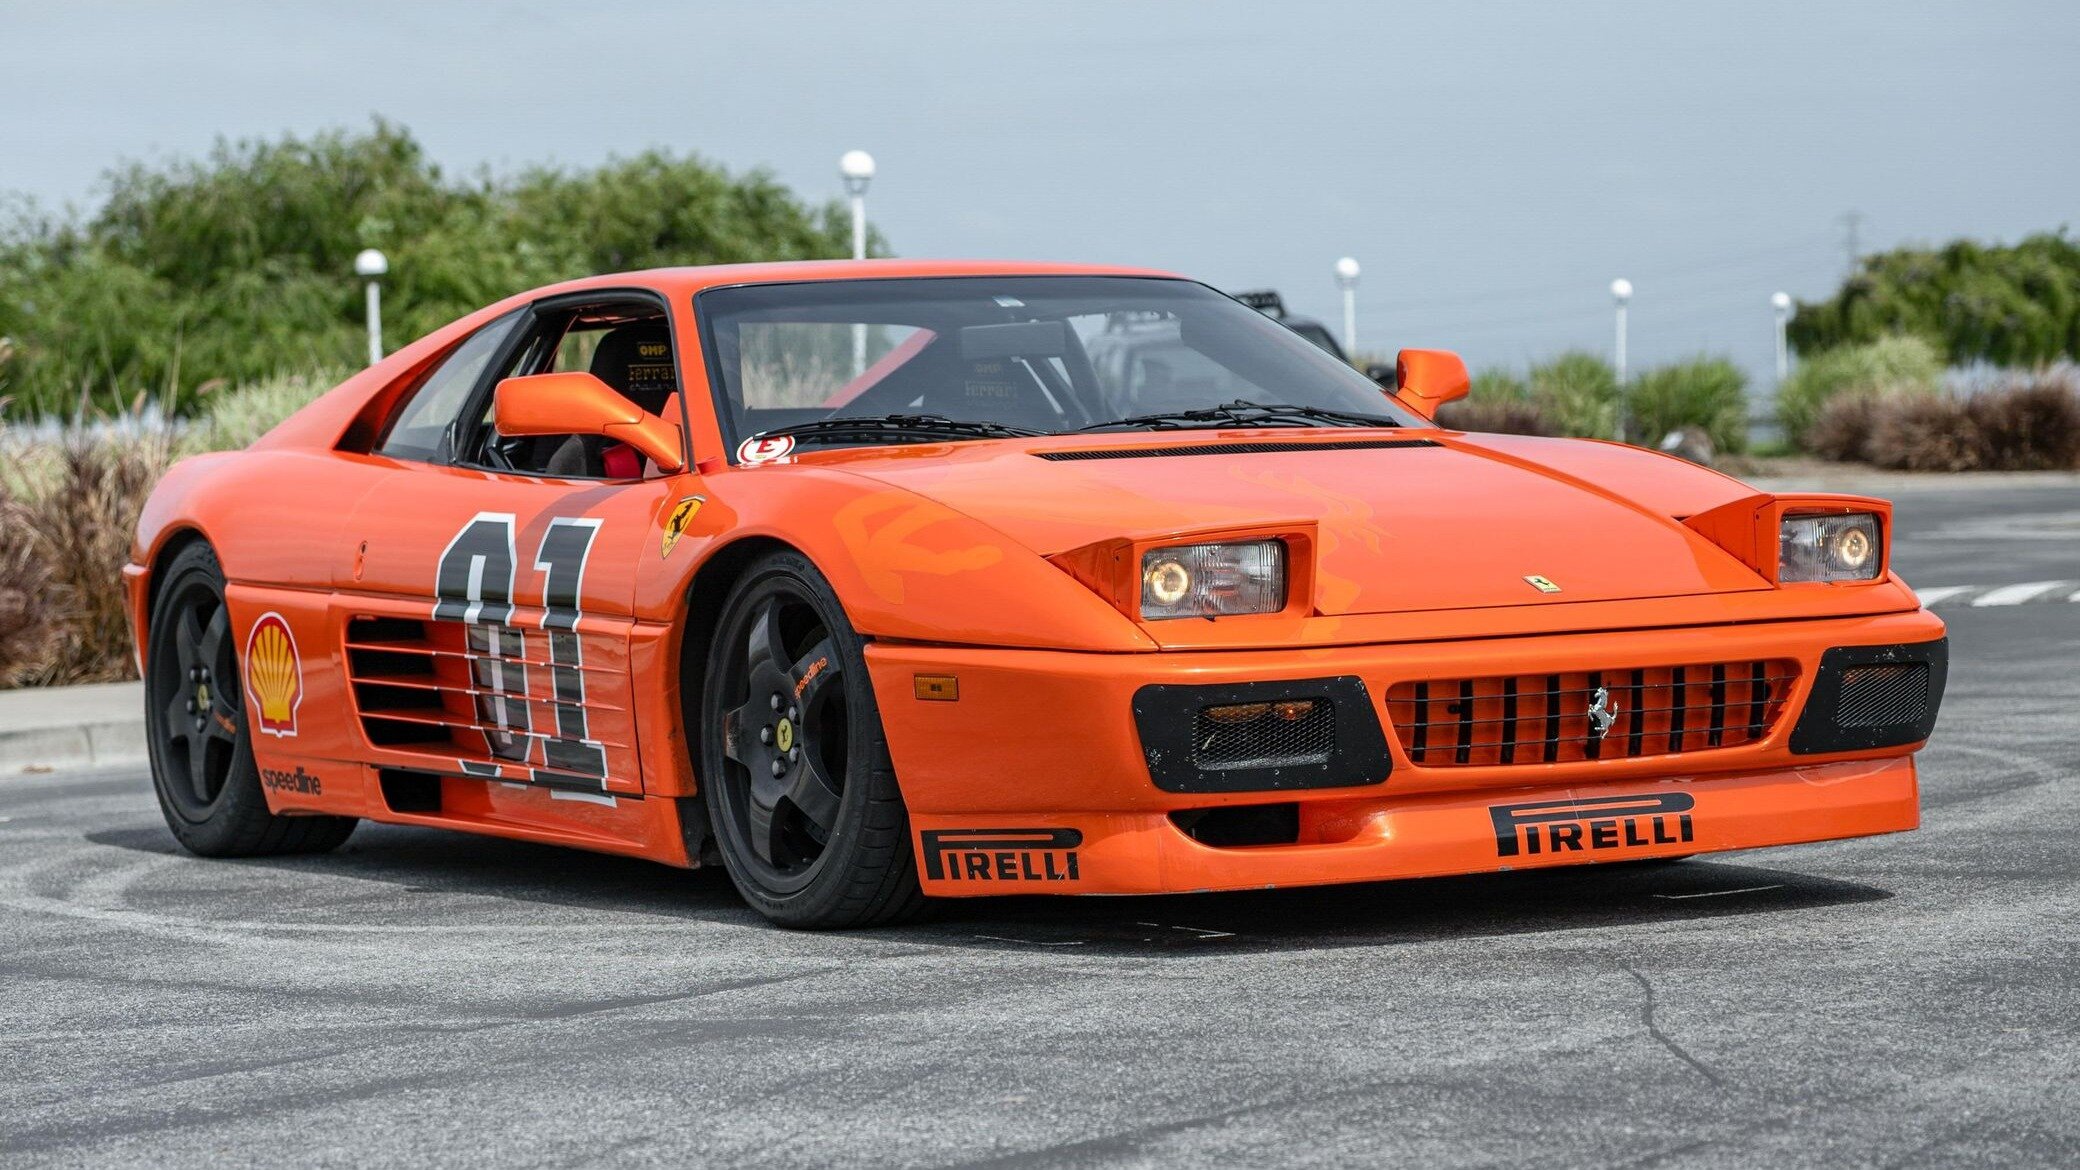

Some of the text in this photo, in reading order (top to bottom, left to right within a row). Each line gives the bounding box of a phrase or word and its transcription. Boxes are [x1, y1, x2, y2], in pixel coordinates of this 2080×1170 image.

[639, 344, 667, 356] OMP
[262, 766, 322, 796] speedline
[1488, 792, 1695, 857] PIRELLI
[921, 828, 1083, 880] PIRELLI
